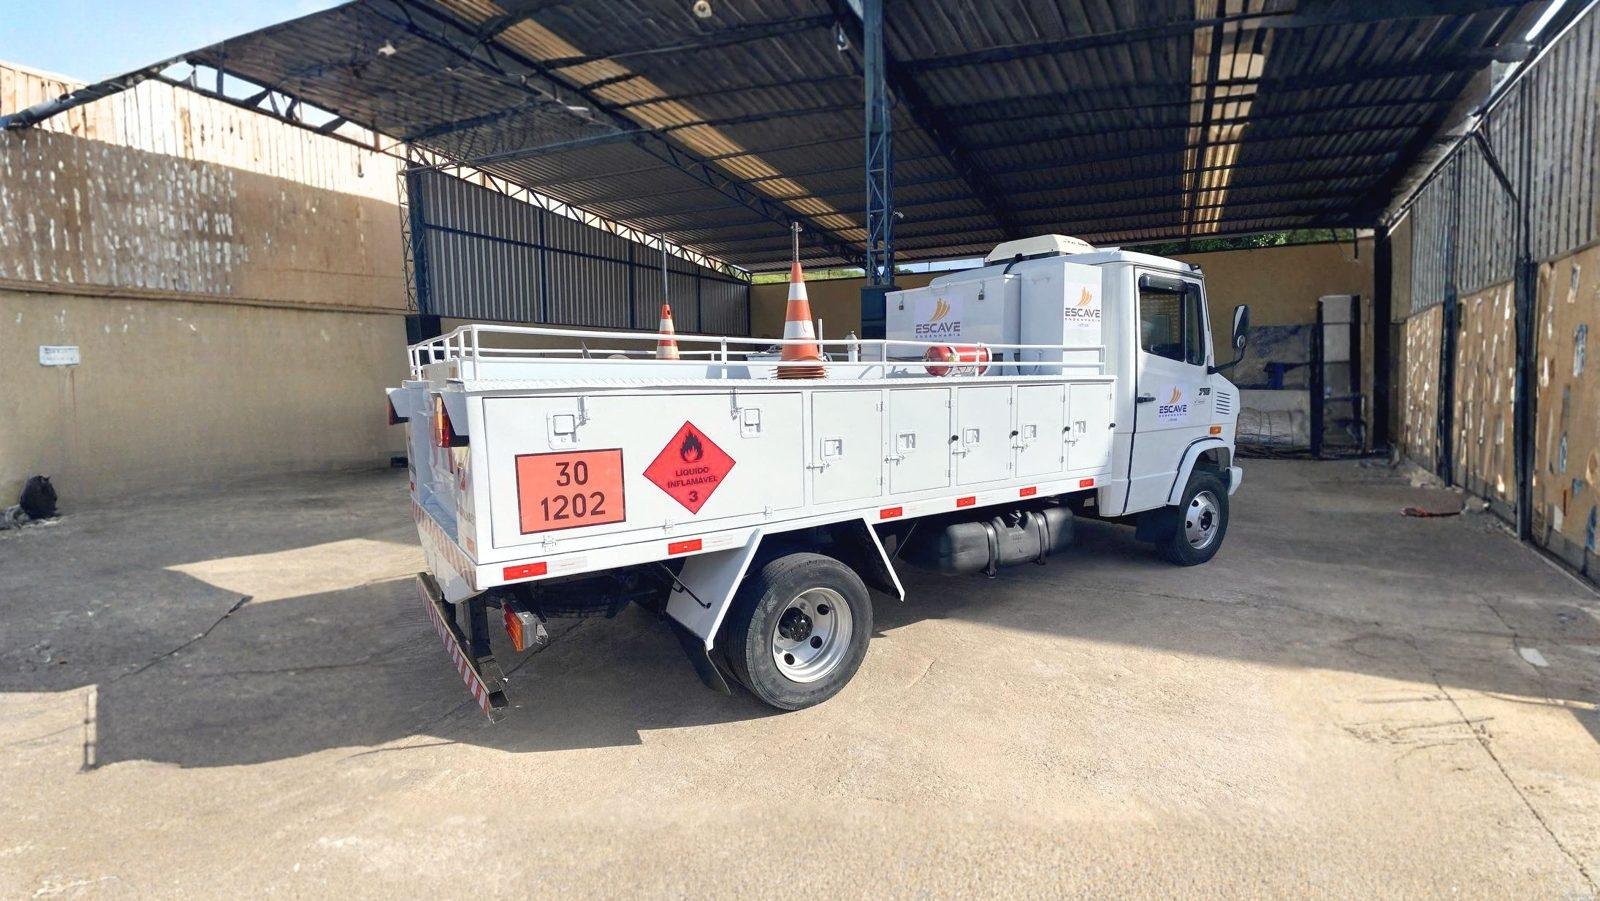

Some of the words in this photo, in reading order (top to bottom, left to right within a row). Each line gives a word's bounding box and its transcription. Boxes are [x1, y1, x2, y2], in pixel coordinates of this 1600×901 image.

[1065, 307, 1100, 318] ESCAVE
[916, 321, 961, 334] ESCAVE
[1159, 404, 1187, 414] ESCAVE
[556, 461, 589, 487] 30
[688, 490, 699, 503] 3
[541, 491, 606, 522] 1202
